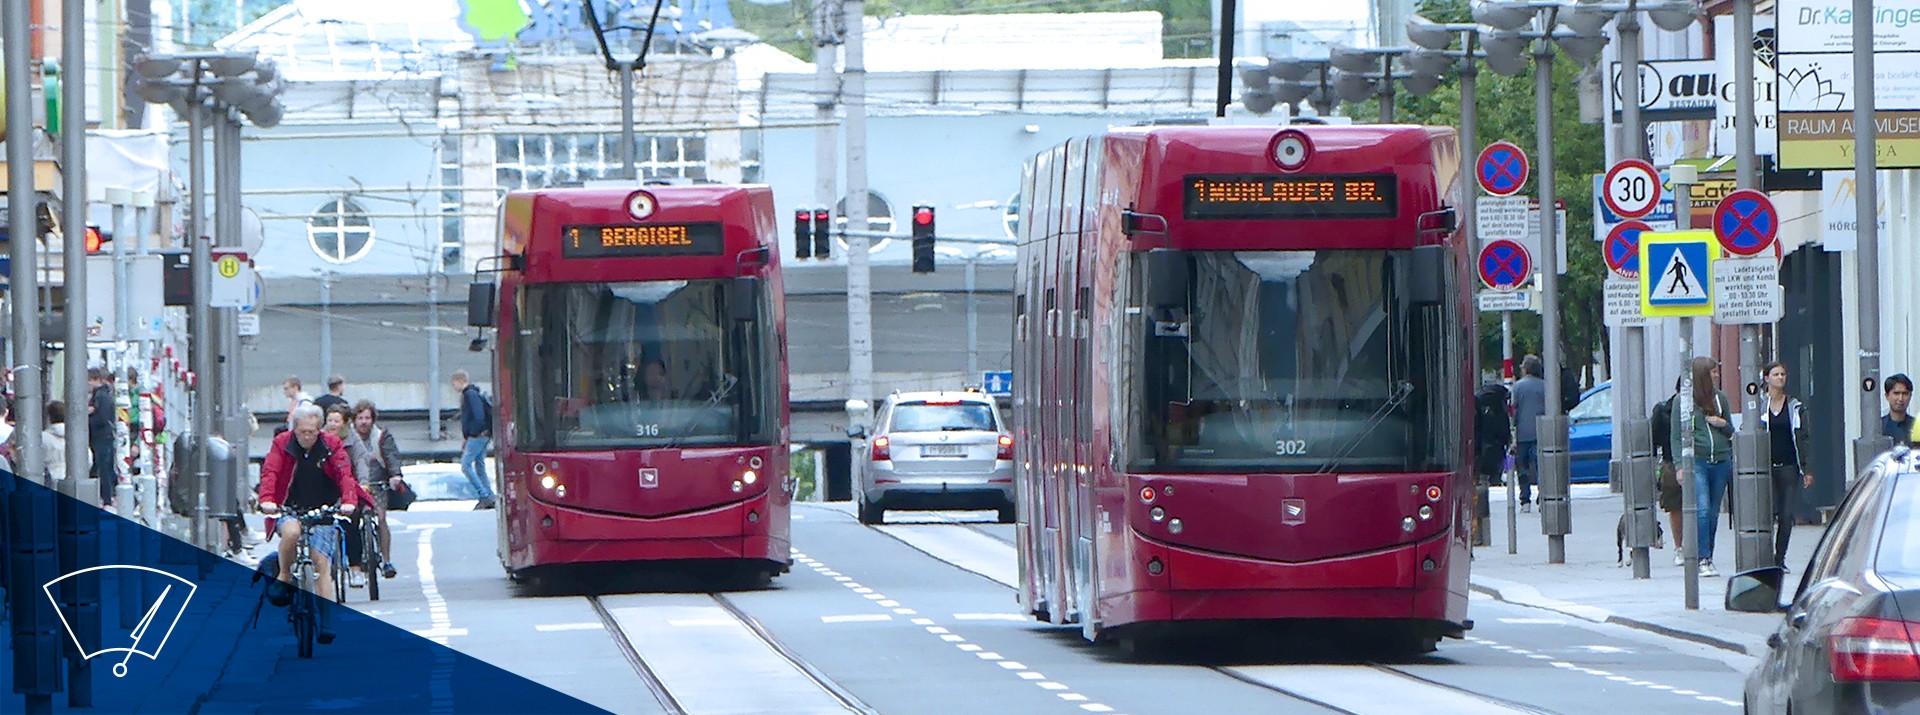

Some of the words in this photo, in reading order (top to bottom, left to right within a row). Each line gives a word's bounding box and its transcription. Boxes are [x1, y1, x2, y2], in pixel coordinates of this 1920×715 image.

[1788, 118, 1836, 134] RAUM
[1874, 117, 1920, 133] MUSE
[1194, 179, 1204, 202] 1
[1345, 182, 1383, 202] BR.
[1618, 176, 1646, 202] 30
[569, 228, 580, 248] 1
[602, 226, 692, 247] BERGISEL
[224, 260, 235, 274] H
[1743, 274, 1755, 282] und
[1757, 273, 1776, 281] Kombi
[1725, 284, 1754, 292] werktags
[1757, 291, 1768, 299] Uhr
[1722, 309, 1750, 318] gestattet
[636, 424, 659, 437] 316
[1275, 440, 1306, 455] 302
